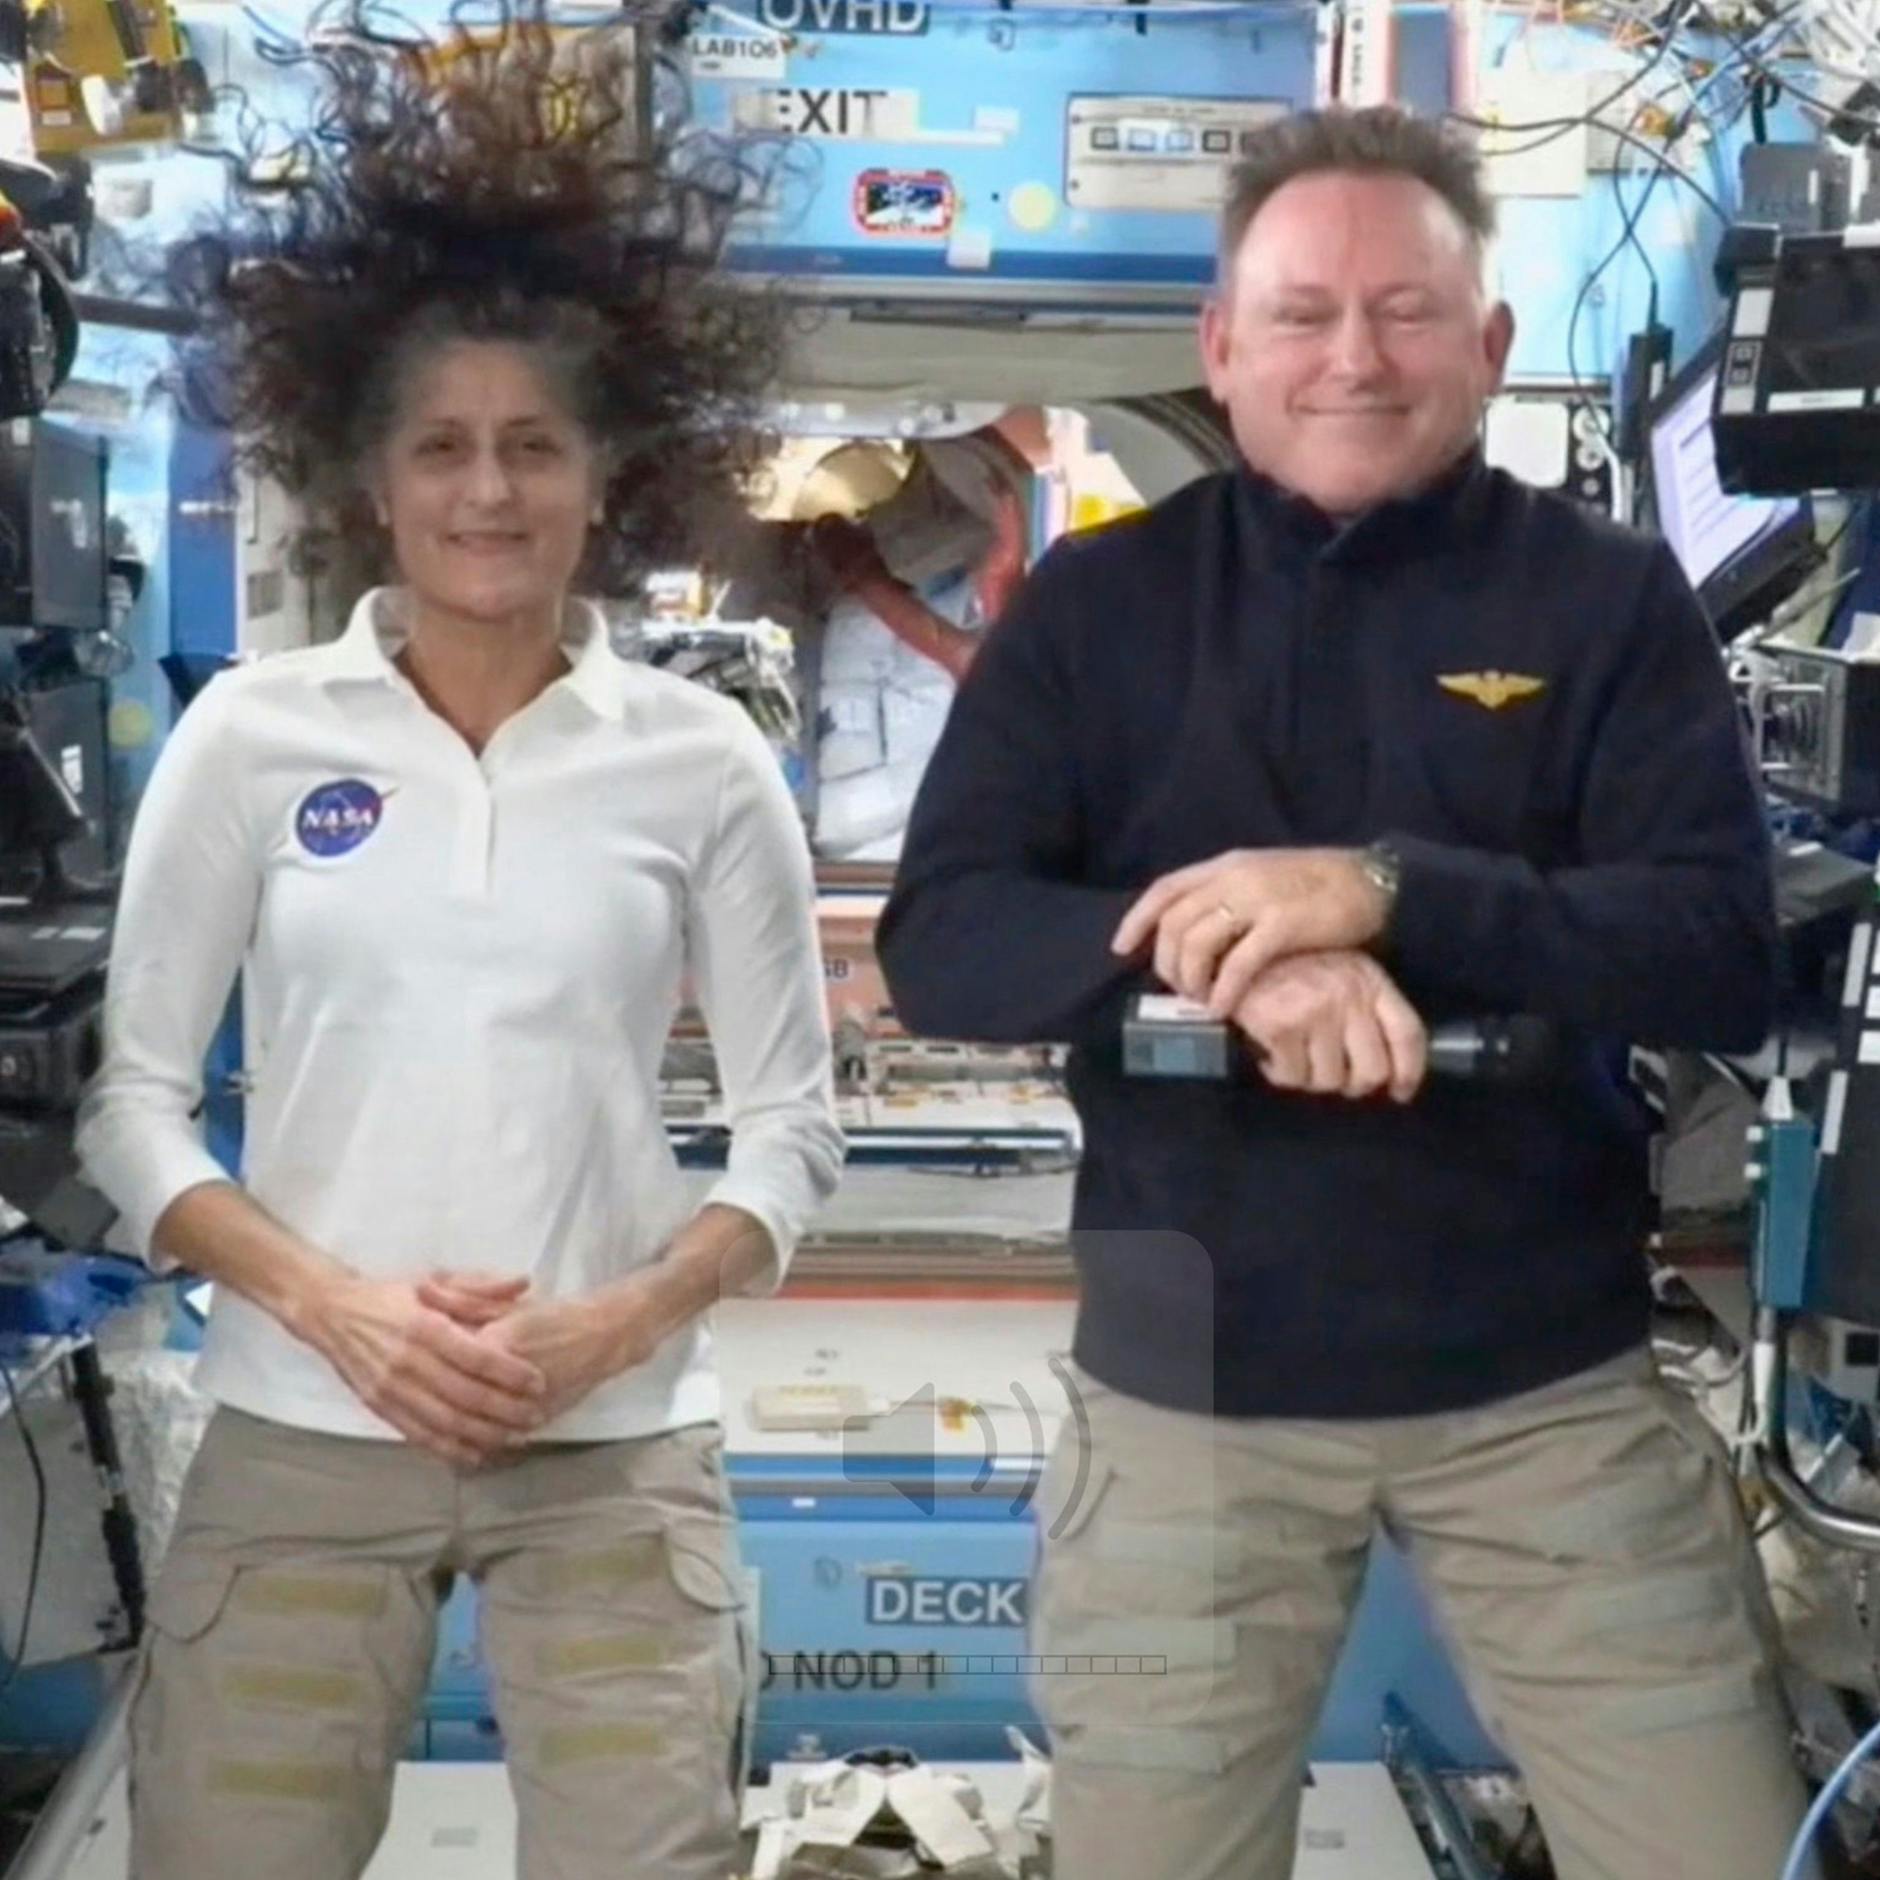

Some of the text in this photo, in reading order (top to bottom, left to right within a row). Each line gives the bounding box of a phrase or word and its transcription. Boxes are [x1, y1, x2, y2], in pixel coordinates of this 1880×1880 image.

[762, 0, 924, 31] OVHD
[766, 89, 888, 135] EXIT
[303, 809, 373, 835] NASA
[872, 1580, 1024, 1624] DECK
[794, 1651, 899, 1690] NOD
[919, 1651, 936, 1690] 1
